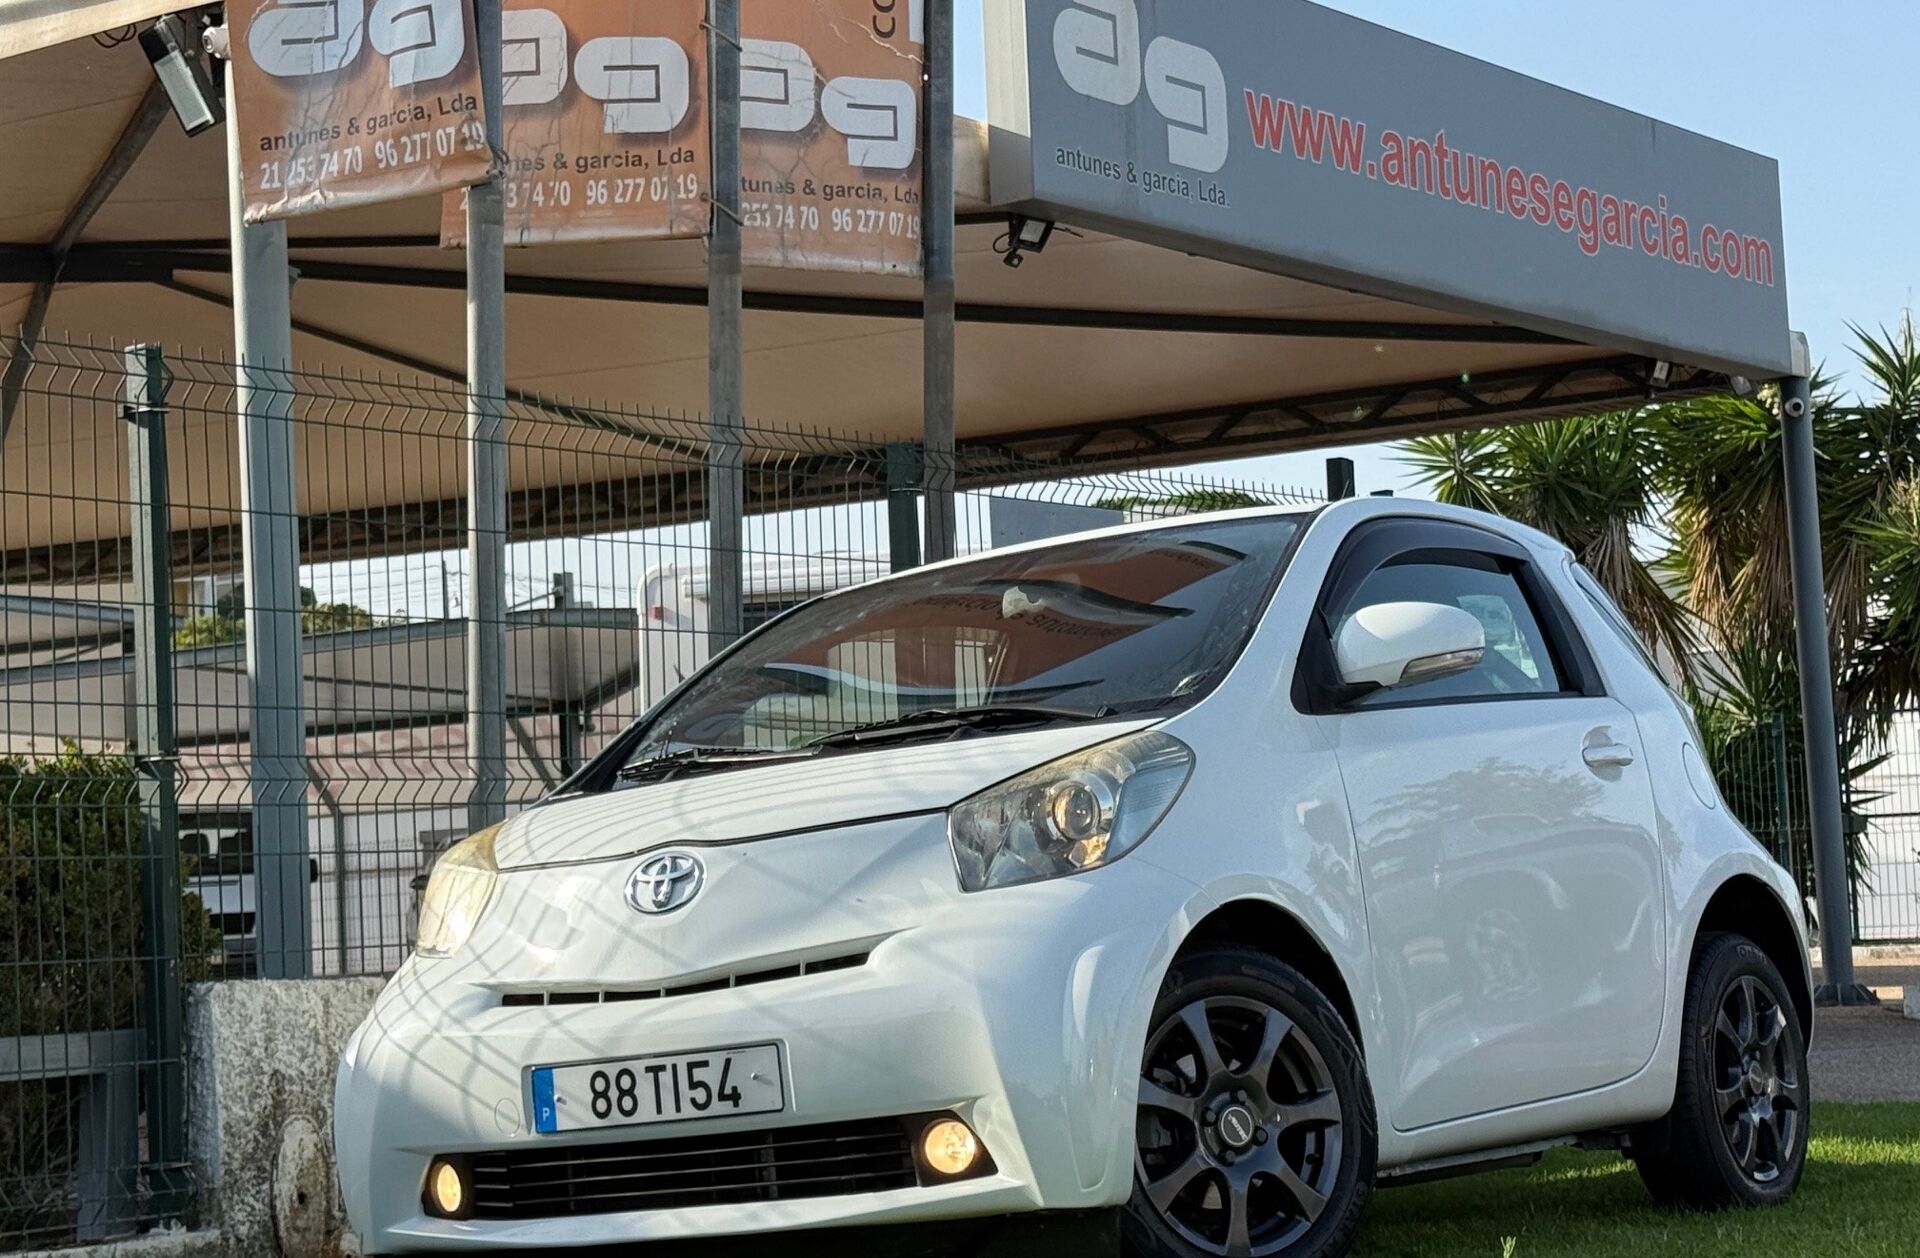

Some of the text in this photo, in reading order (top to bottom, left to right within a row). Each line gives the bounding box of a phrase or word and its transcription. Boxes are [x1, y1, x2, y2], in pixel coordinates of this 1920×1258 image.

[260, 93, 477, 151] antunes & garcia, Lda
[260, 162, 281, 190] 21
[320, 150, 339, 180] 74
[343, 145, 363, 176] 70
[375, 139, 398, 169] 96
[400, 131, 431, 164] 277
[436, 127, 456, 157] 07
[553, 152, 568, 170] &
[575, 150, 649, 173] garcia,
[657, 147, 694, 166] Lda
[1056, 146, 1231, 207] antunes & garcia, Lda.
[523, 180, 545, 207] 74
[550, 180, 571, 207] 70
[586, 178, 608, 205] 96
[614, 177, 646, 204] 277
[651, 175, 669, 202] 07
[677, 173, 698, 199] 19
[741, 177, 795, 195] tunes
[803, 178, 816, 196] &
[823, 181, 888, 203] garcia,
[1243, 88, 1774, 286] www.antunesegarcia.com
[775, 204, 796, 229] 74
[800, 206, 819, 230] 70
[832, 207, 853, 232] 96
[857, 208, 885, 233] 277
[889, 210, 905, 237] 07
[590, 1057, 742, 1120] 88TI54
[542, 1107, 551, 1121] P
